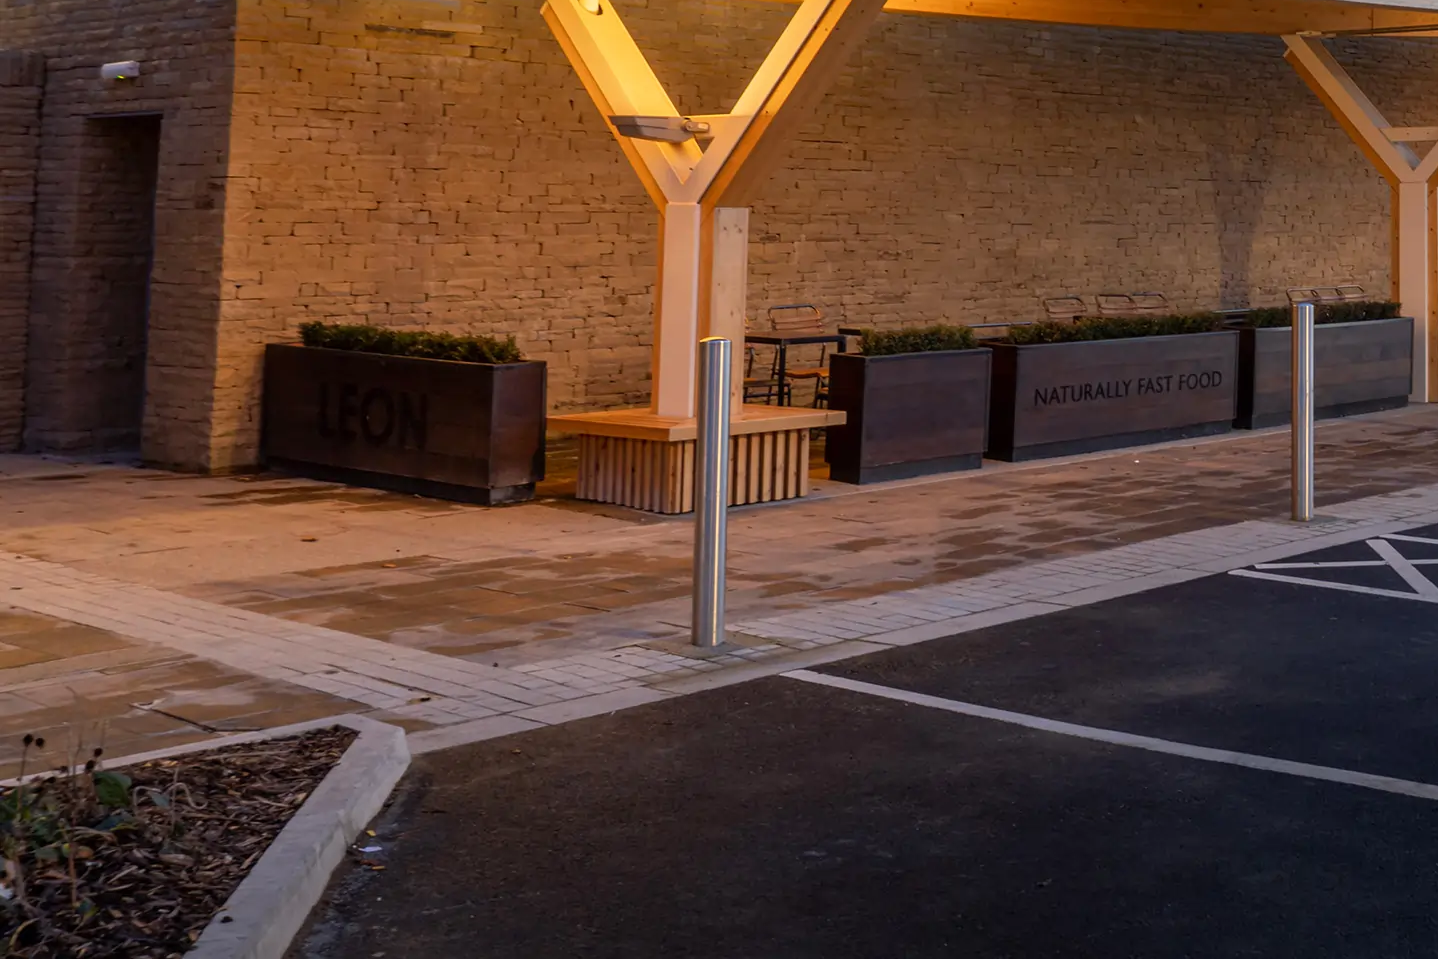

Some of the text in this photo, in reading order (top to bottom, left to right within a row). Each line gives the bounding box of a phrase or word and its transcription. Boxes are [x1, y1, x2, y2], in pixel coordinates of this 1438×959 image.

[318, 380, 428, 448] LEON
[1034, 371, 1223, 406] NATURALLY FAST FOOD
